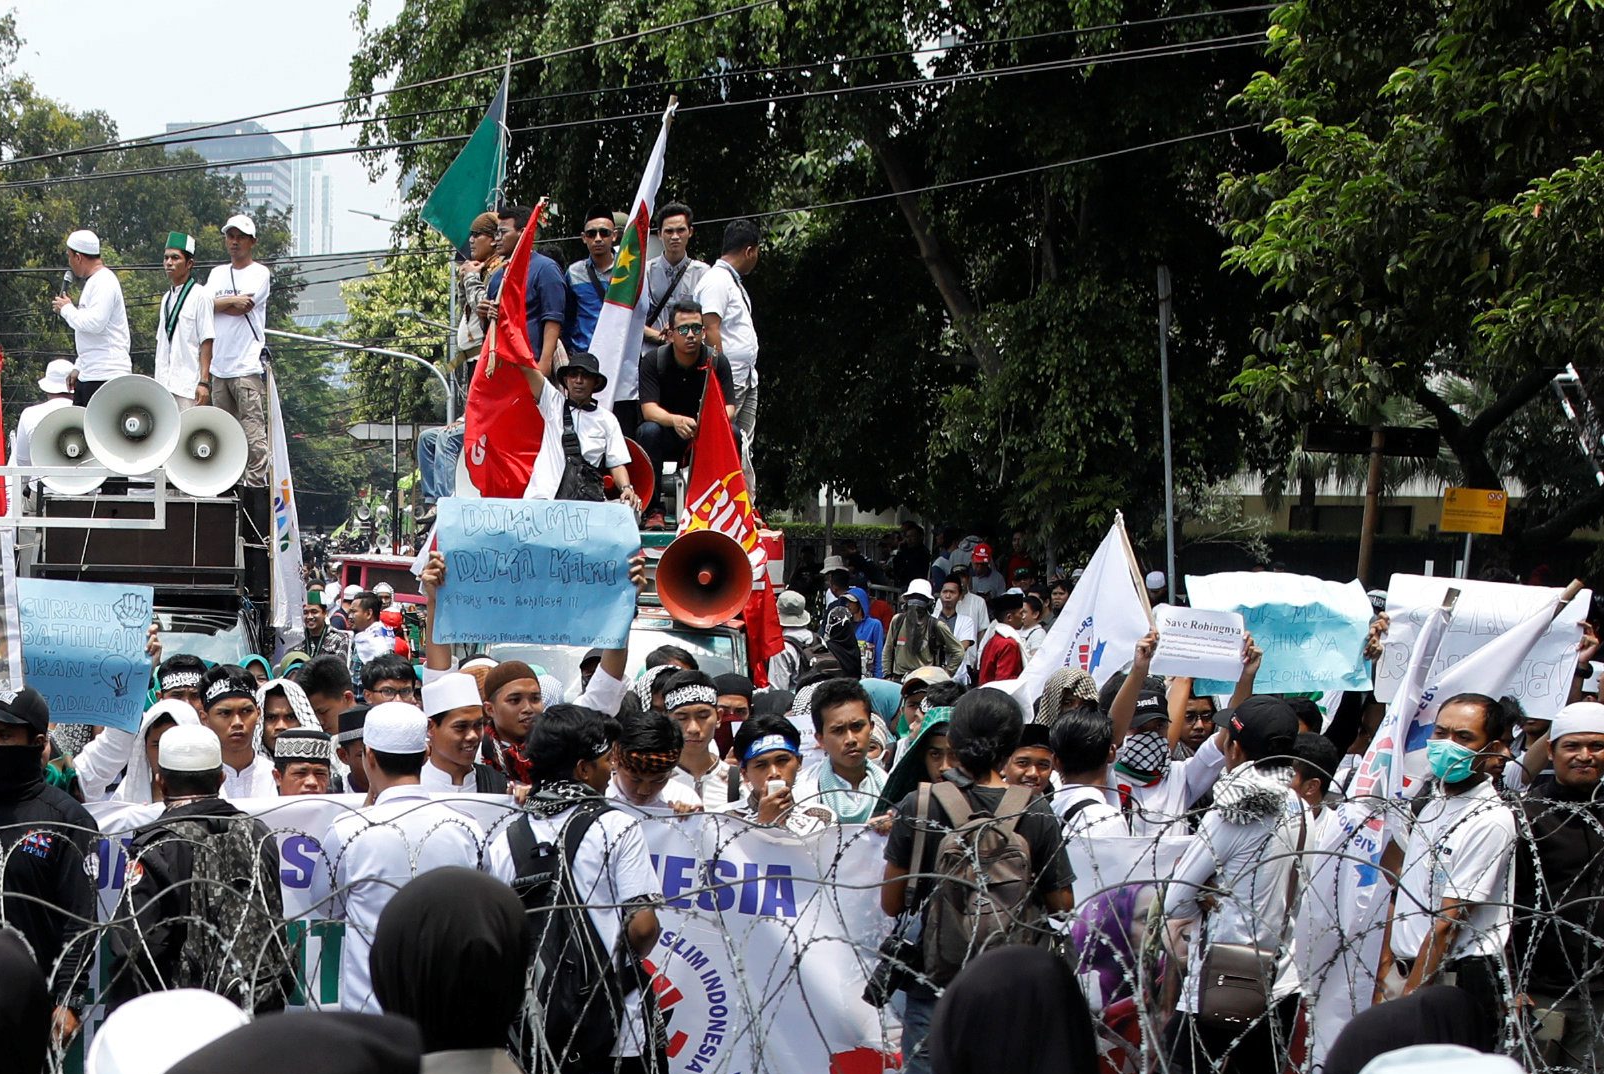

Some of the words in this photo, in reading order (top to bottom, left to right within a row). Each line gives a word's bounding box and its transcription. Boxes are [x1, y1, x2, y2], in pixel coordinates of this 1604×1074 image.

[453, 546, 536, 583] DUKA
[20, 598, 111, 622] CURKAN
[20, 621, 142, 654] BATHILAN
[1165, 617, 1188, 629] Save
[1190, 620, 1241, 637] Rohingnya
[1259, 635, 1339, 656] OHINGYA
[43, 694, 139, 721] ADILAN!!
[683, 968, 729, 1074] INDONESIA
